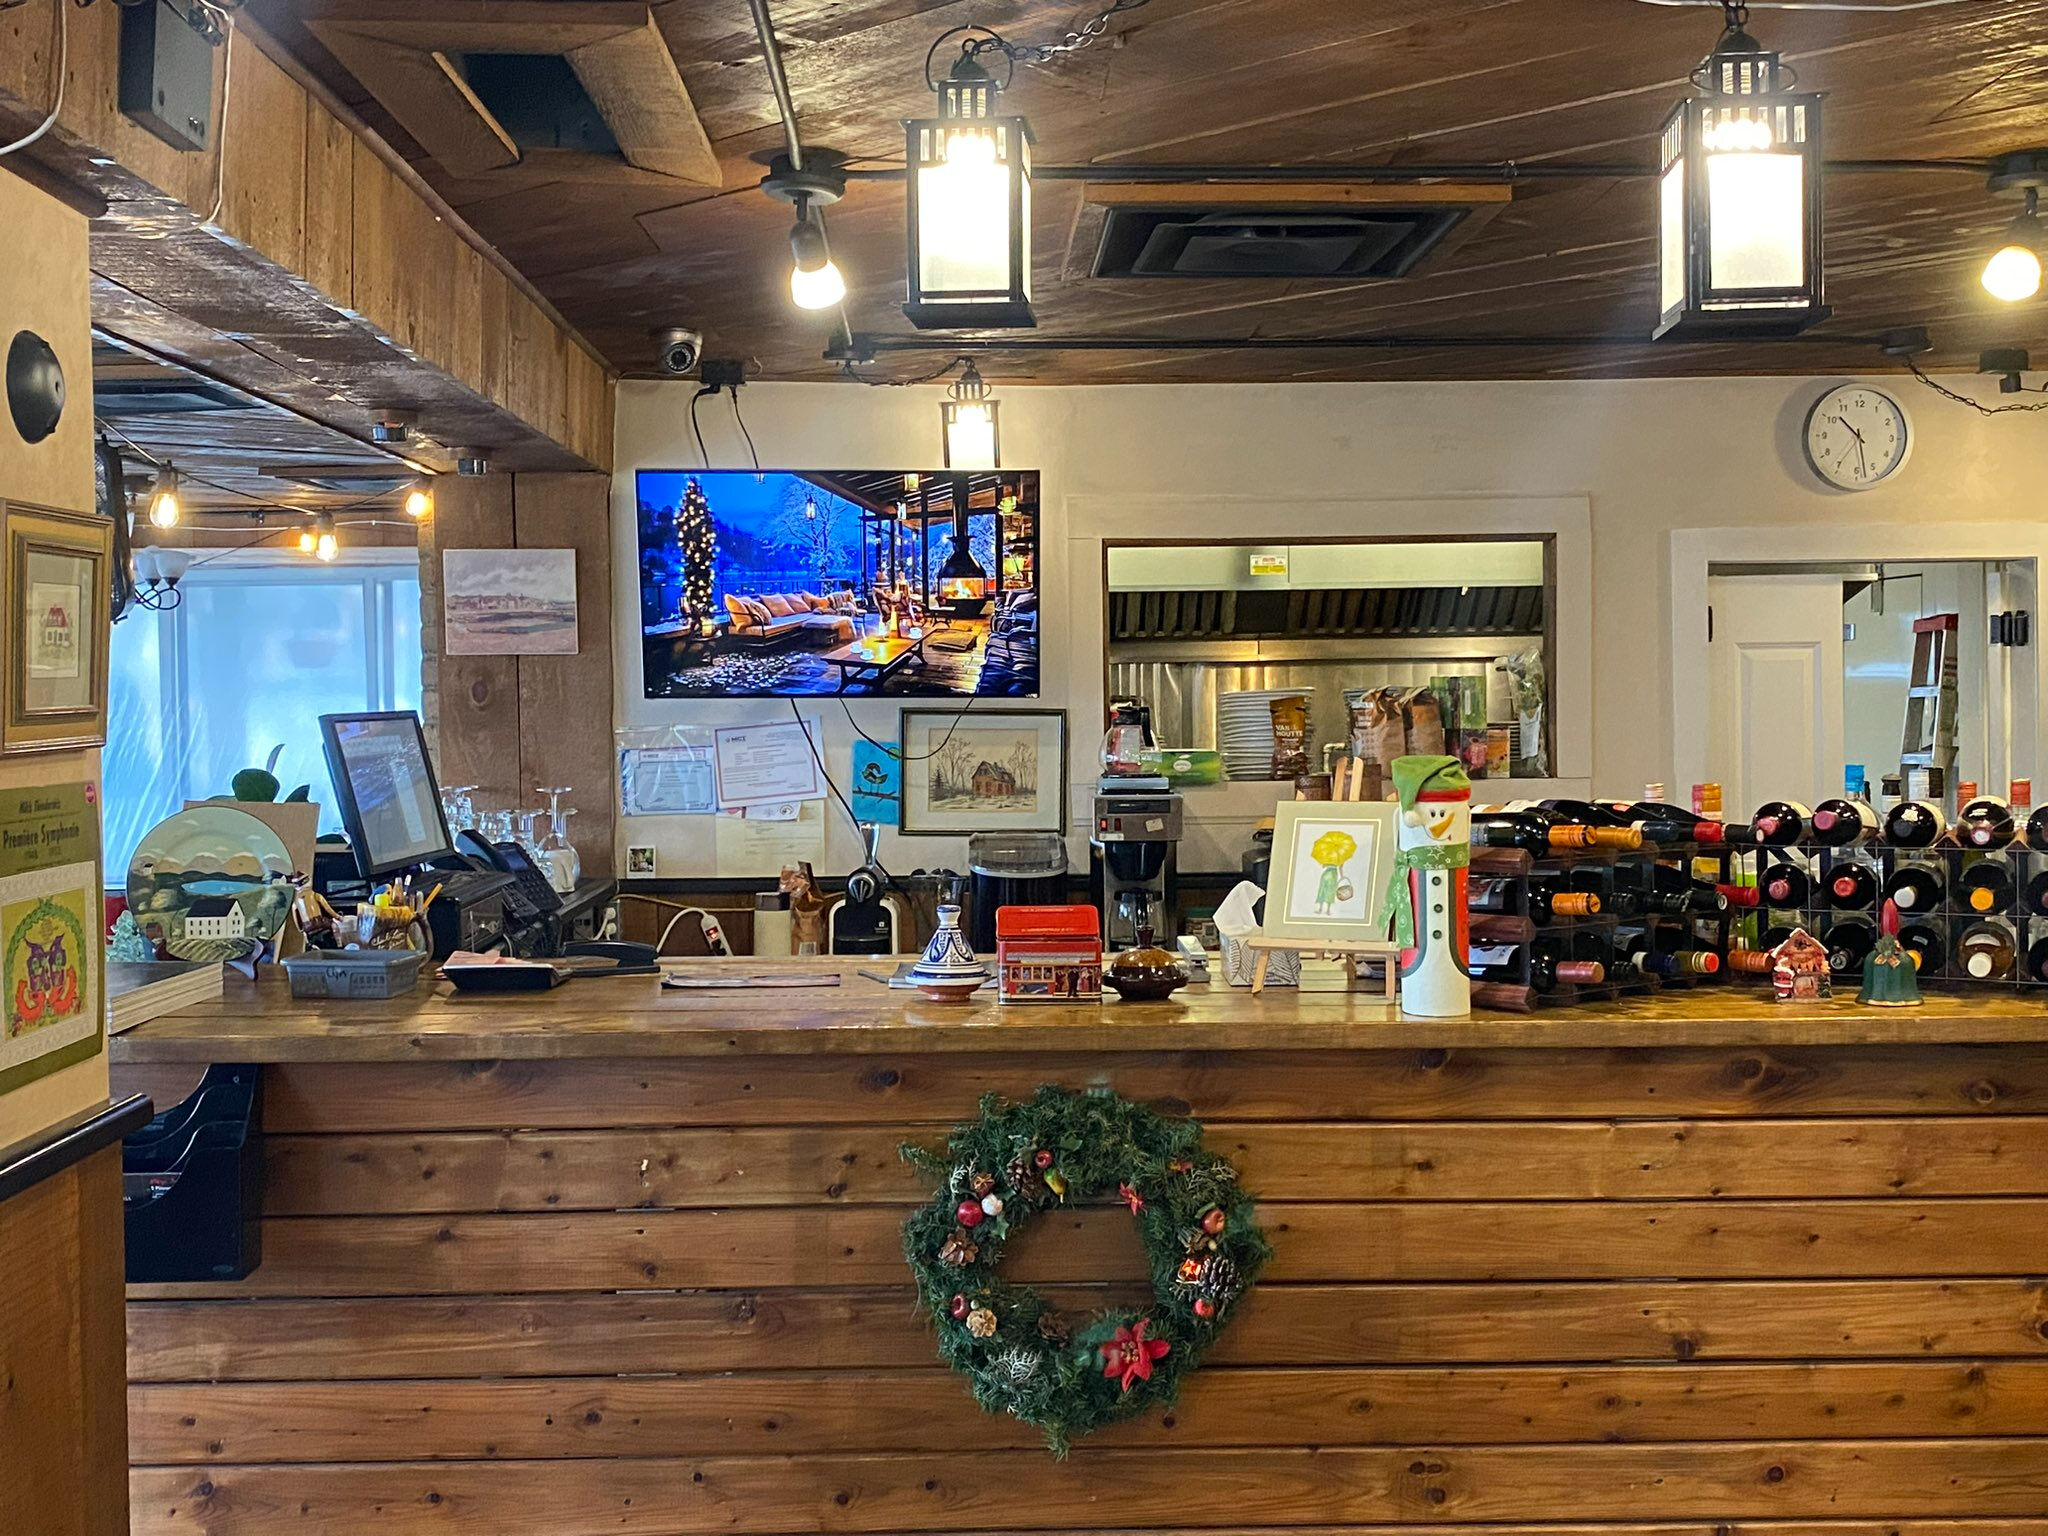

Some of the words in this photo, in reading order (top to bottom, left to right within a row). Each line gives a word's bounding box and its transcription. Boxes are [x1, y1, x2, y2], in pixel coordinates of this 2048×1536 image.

[1839, 404, 1848, 412] 11
[1855, 400, 1865, 408] 12
[1827, 416, 1837, 424] 10
[1884, 418, 1891, 426] 2
[1822, 432, 1827, 440] 9
[1825, 448, 1830, 456] 8
[1883, 450, 1889, 458] 4
[1836, 461, 1842, 469] 7
[1870, 463, 1876, 471] 5
[1854, 467, 1860, 475] 6
